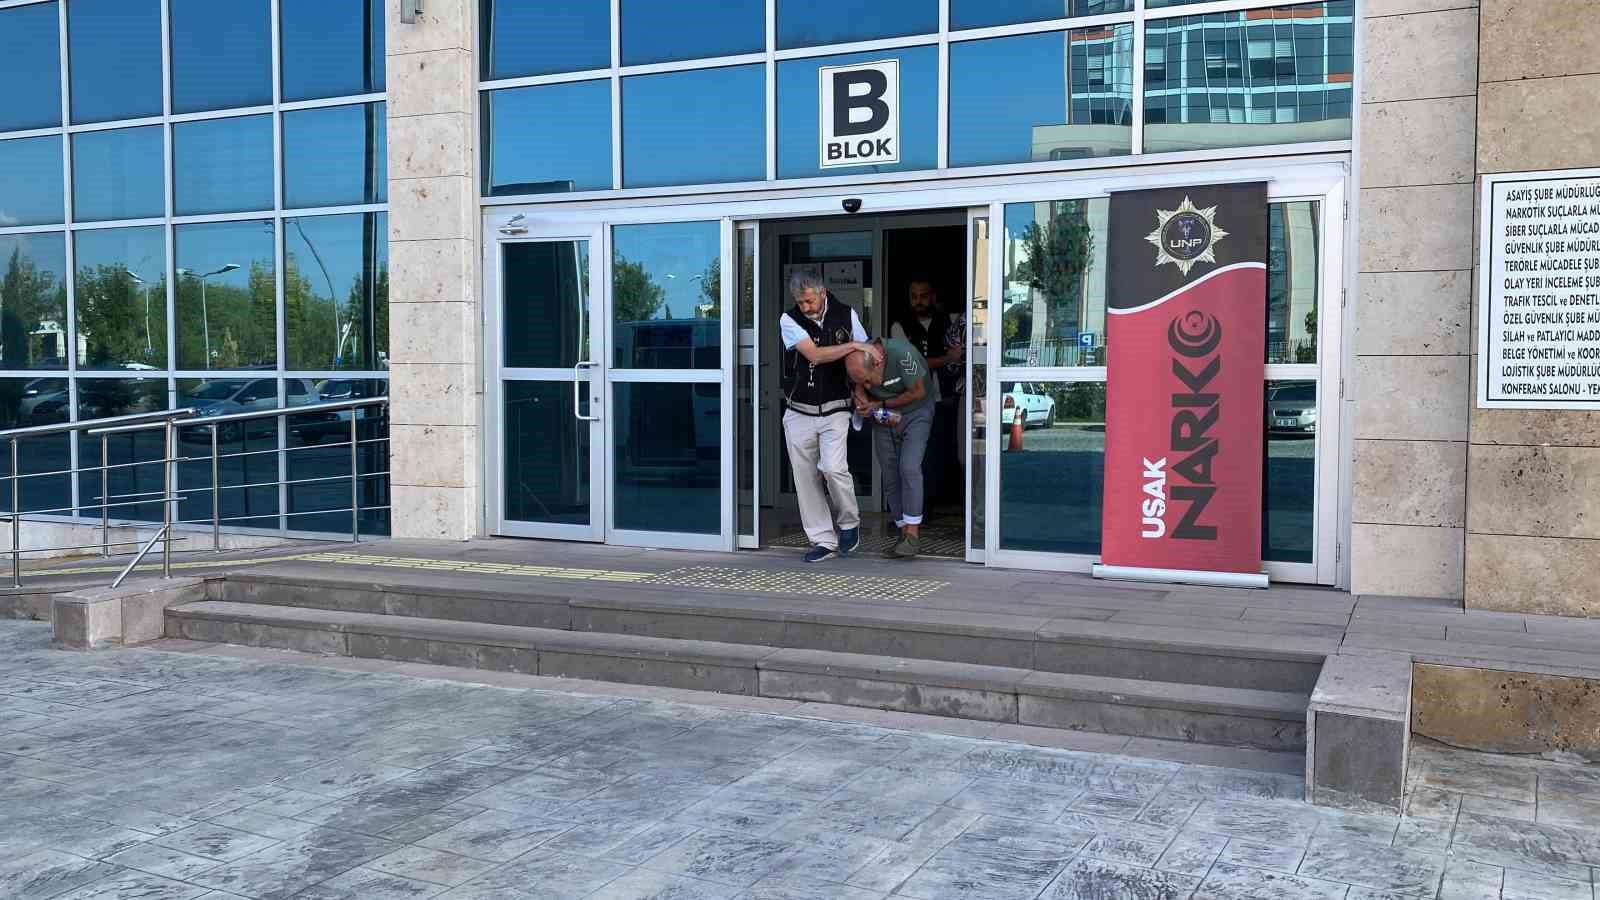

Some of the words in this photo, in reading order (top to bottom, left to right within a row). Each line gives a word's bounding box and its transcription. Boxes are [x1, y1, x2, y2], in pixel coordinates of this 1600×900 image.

[833, 69, 889, 137] B
[828, 138, 892, 160] BLOK
[1506, 185, 1532, 203] ASAYİŞ
[1534, 188, 1554, 203] ŞUBE
[1506, 203, 1546, 219] NARKOTİK
[1547, 205, 1588, 220] SUÇLARLA
[1505, 222, 1526, 237] SİBER
[1528, 223, 1568, 238] SUÇLARLA
[1570, 220, 1600, 234] MÜCAD
[1170, 238, 1202, 248] UNP
[1505, 239, 1544, 254] GÜVENLİK
[1545, 241, 1565, 257] ŞUBE
[1504, 257, 1538, 272] TERÖRLE
[1540, 256, 1582, 271] MÜCADELE
[1504, 277, 1524, 289] OLAY
[1526, 276, 1543, 289] YERİ
[1545, 275, 1583, 289] İNCELEME
[1504, 293, 1531, 307] TRAFİK
[1532, 292, 1558, 307] TESCİL
[1569, 294, 1600, 306] DENETL
[1503, 310, 1524, 325] ÖZEL
[1525, 310, 1564, 325] GÜVENLİK
[1565, 312, 1585, 327] ŞUBE
[1503, 328, 1525, 342] SİLAH
[1527, 334, 1535, 342] ve
[1536, 330, 1575, 342] PATLAYICI
[1577, 330, 1600, 342] MADD
[1502, 348, 1526, 360] BELGE
[1527, 345, 1566, 360] YÖNETİMİ
[1567, 351, 1576, 360] ve
[1502, 362, 1535, 377] LOJİSTİK
[1536, 365, 1556, 380] ŞUBE
[1501, 383, 1547, 395] KONFERANS
[1549, 383, 1581, 395] SALONU
